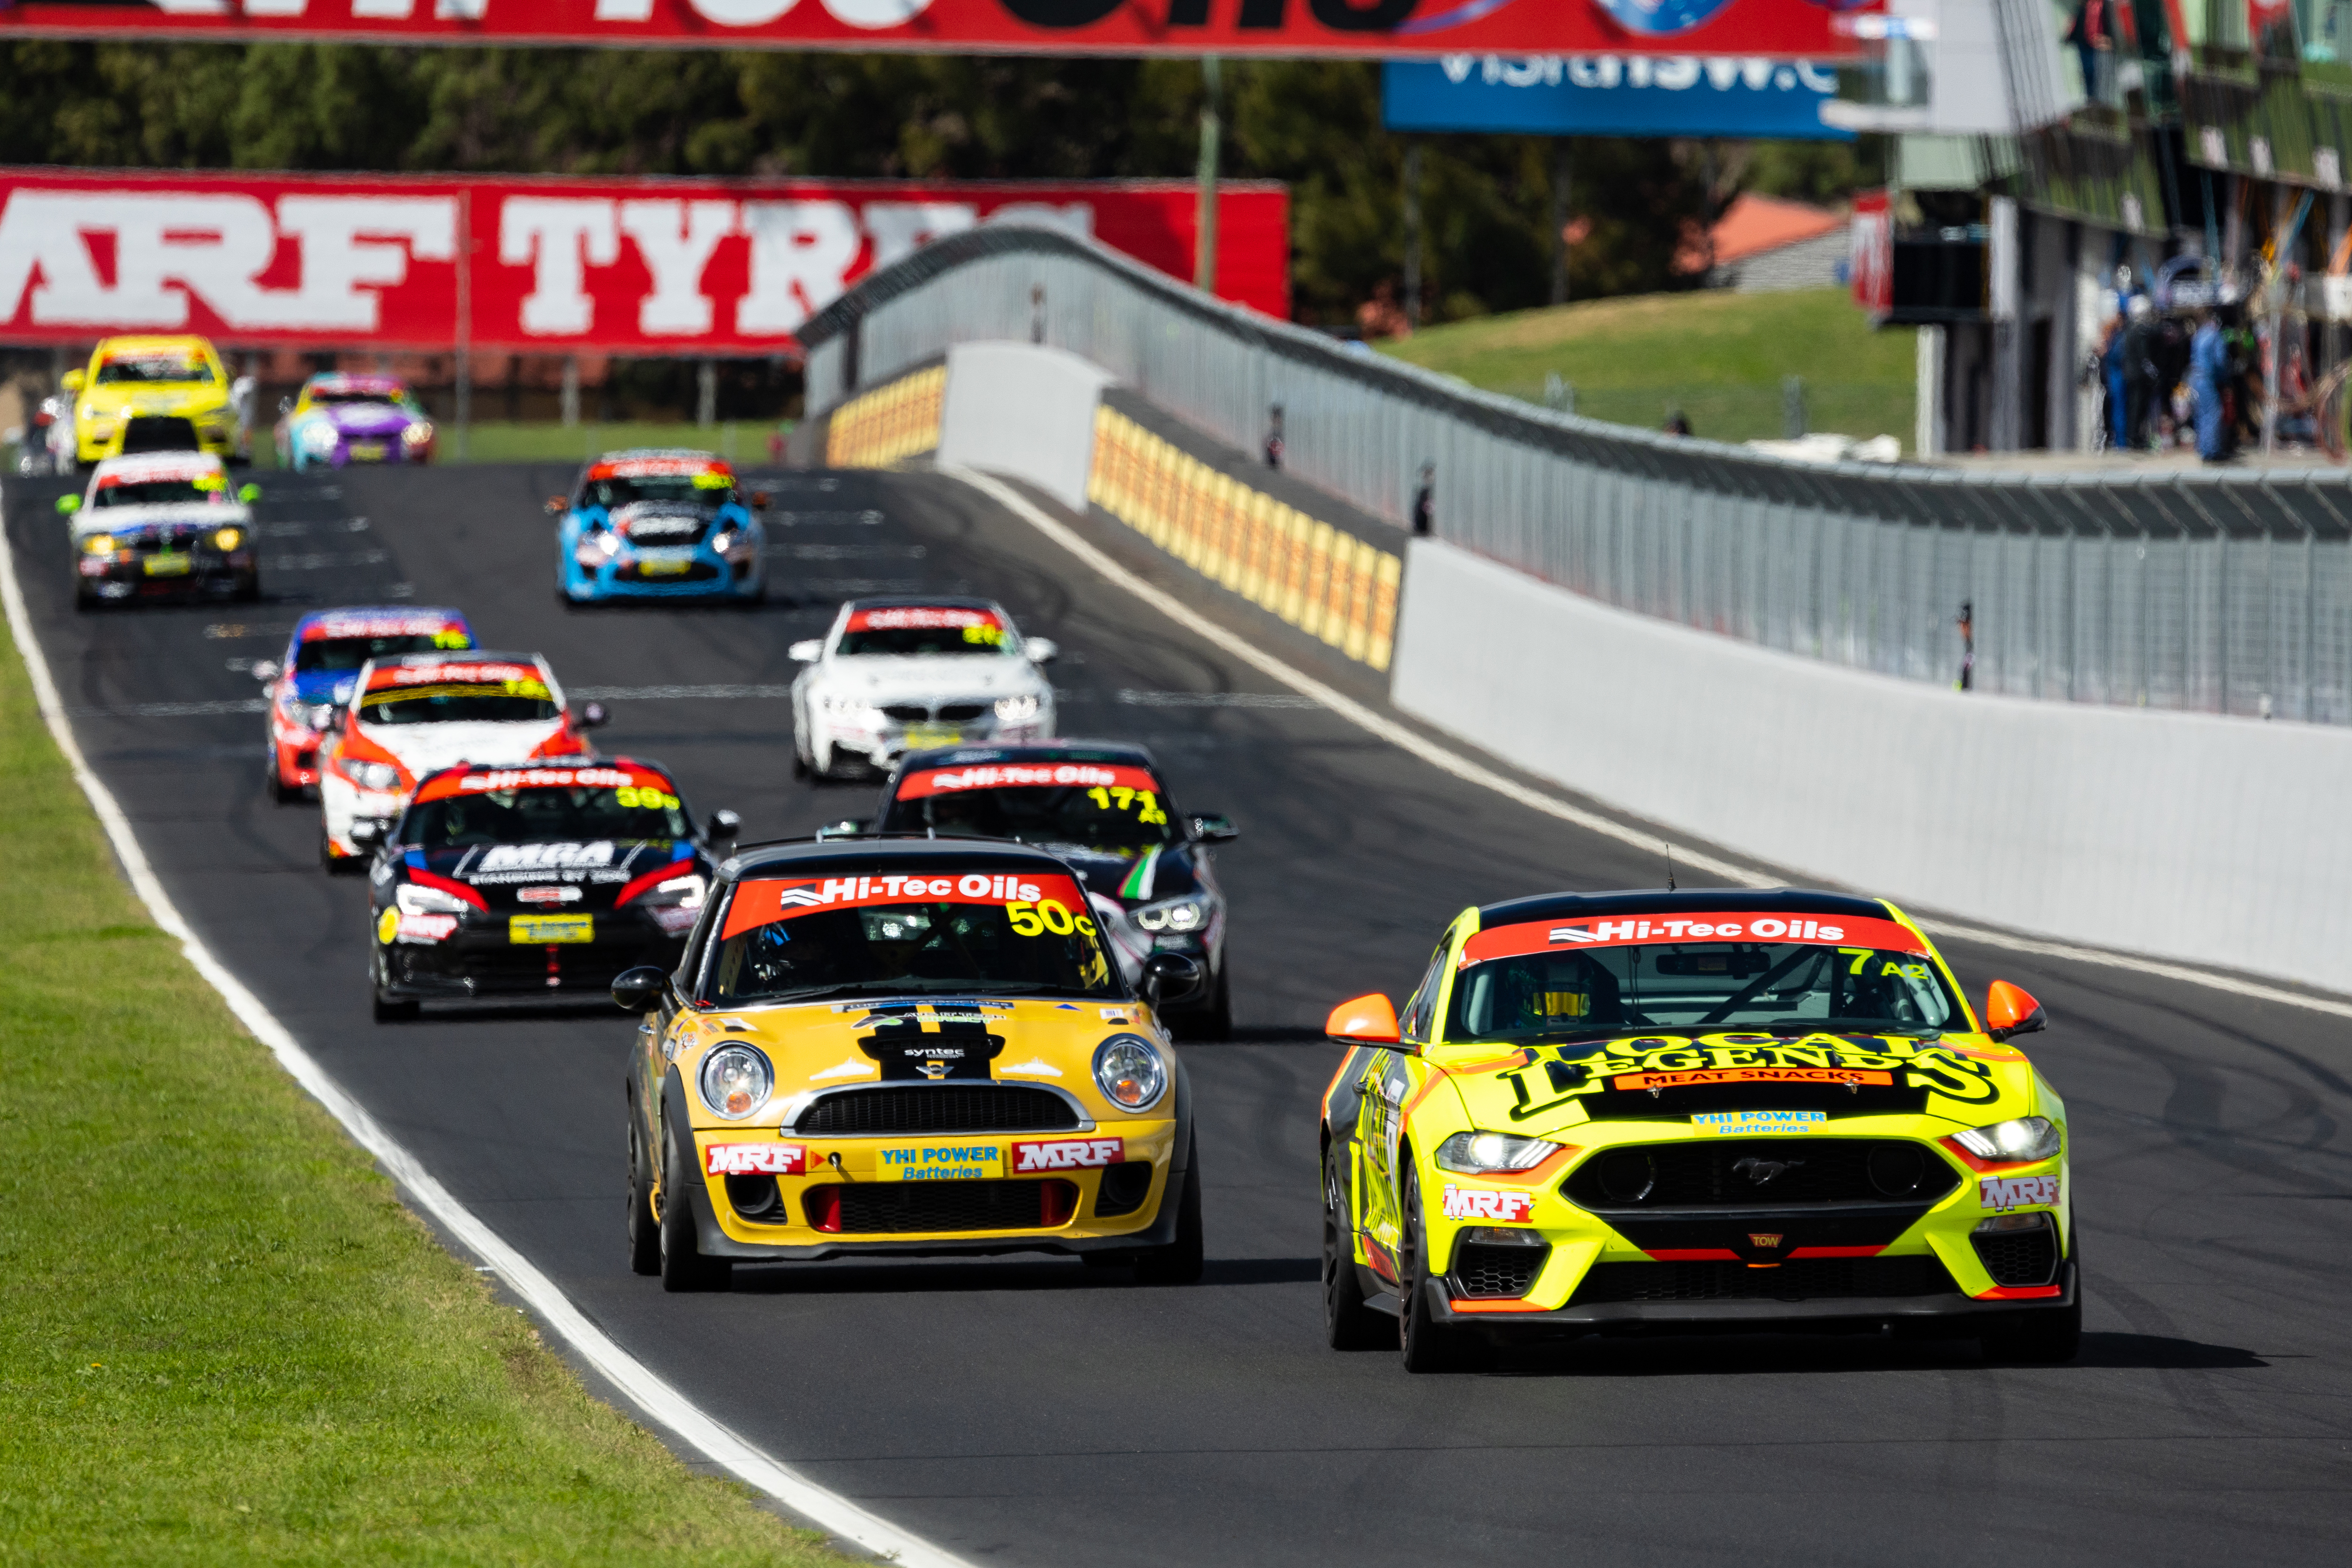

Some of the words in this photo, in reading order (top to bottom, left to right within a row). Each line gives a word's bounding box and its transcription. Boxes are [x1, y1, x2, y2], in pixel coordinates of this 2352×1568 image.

[498, 194, 1096, 334] TYR
[1088, 786, 1156, 811] 171
[822, 876, 952, 904] Hi-Tec
[958, 874, 1041, 902] Oils
[1598, 920, 1742, 941] Hi-Tec
[1750, 919, 1844, 940] Oils
[1837, 947, 1874, 975] 7
[1881, 962, 1929, 979] A2
[904, 1047, 965, 1057] syntec
[1521, 1032, 1956, 1065] LOCAL
[1506, 1047, 1994, 1114] LEGENDS
[1643, 1072, 1729, 1085] MEAT
[1741, 1070, 1864, 1081] SNACKS
[1693, 1113, 1733, 1124] YHI
[1740, 1111, 1826, 1123] POWER
[1720, 1123, 1810, 1134] Batteries
[708, 1146, 802, 1173] MRF
[880, 1149, 916, 1165] YHI
[922, 1146, 999, 1163] POWER
[1017, 1140, 1120, 1170] MRF
[902, 1166, 983, 1180] Batteries
[1443, 1188, 1531, 1220] MRF
[1980, 1174, 2058, 1208] MRF
[1753, 1236, 1780, 1247] TOW
